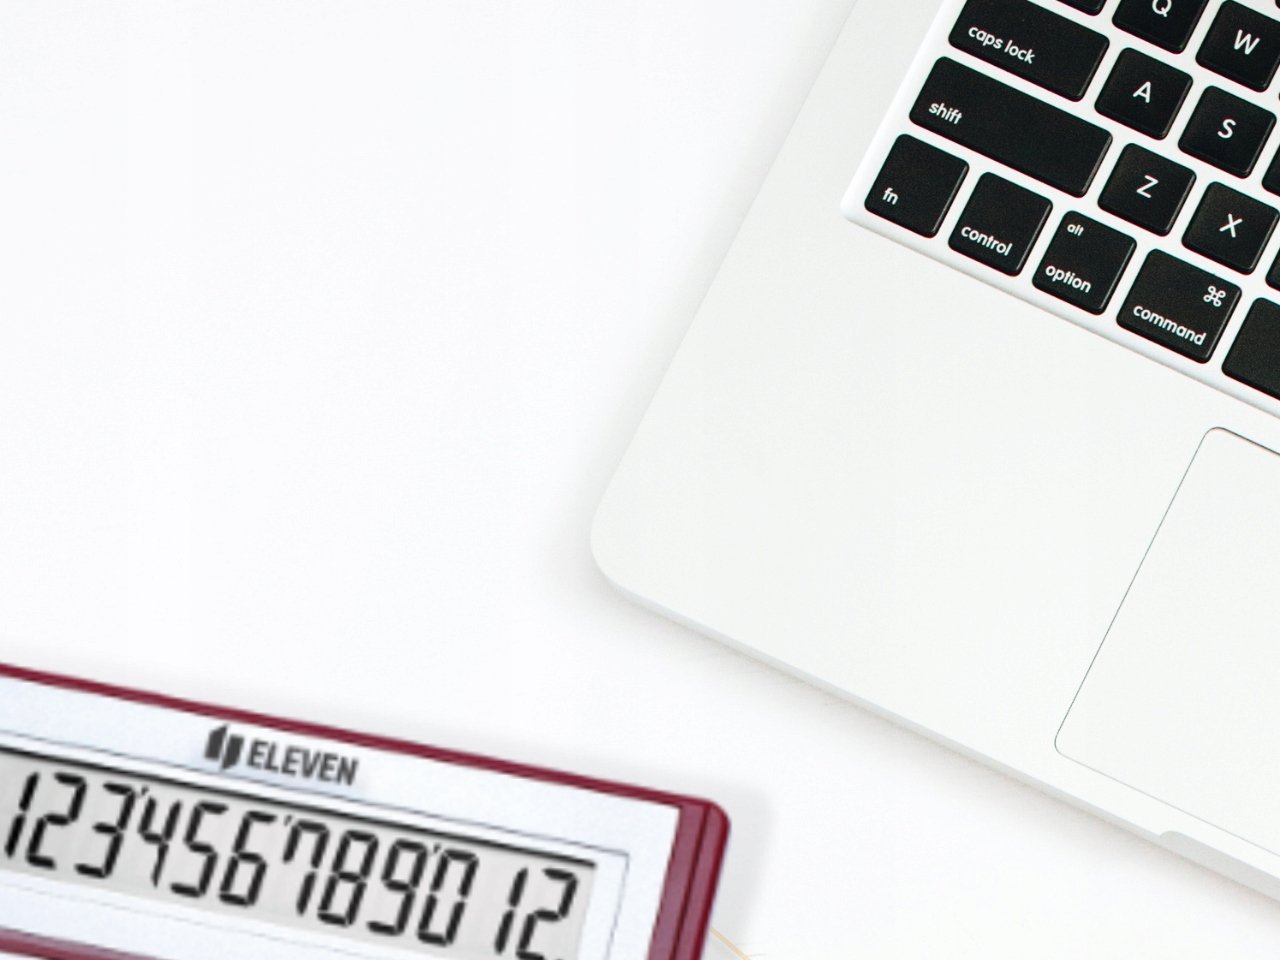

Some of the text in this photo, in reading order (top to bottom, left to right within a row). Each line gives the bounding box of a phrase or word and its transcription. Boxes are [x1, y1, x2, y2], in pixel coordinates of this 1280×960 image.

[1151, 0, 1173, 18] Q
[968, 26, 1035, 64] caps lock
[1233, 29, 1260, 55] W
[1132, 81, 1152, 104] A
[928, 102, 962, 125] shift
[1217, 118, 1237, 139] S
[882, 187, 899, 205] fn
[1136, 174, 1159, 199] Z
[1066, 223, 1084, 237] alt
[1219, 213, 1243, 238] X
[960, 226, 1013, 256] control
[1045, 265, 1092, 293] option
[1133, 305, 1207, 346] command
[247, 739, 358, 785] ELEVEN
